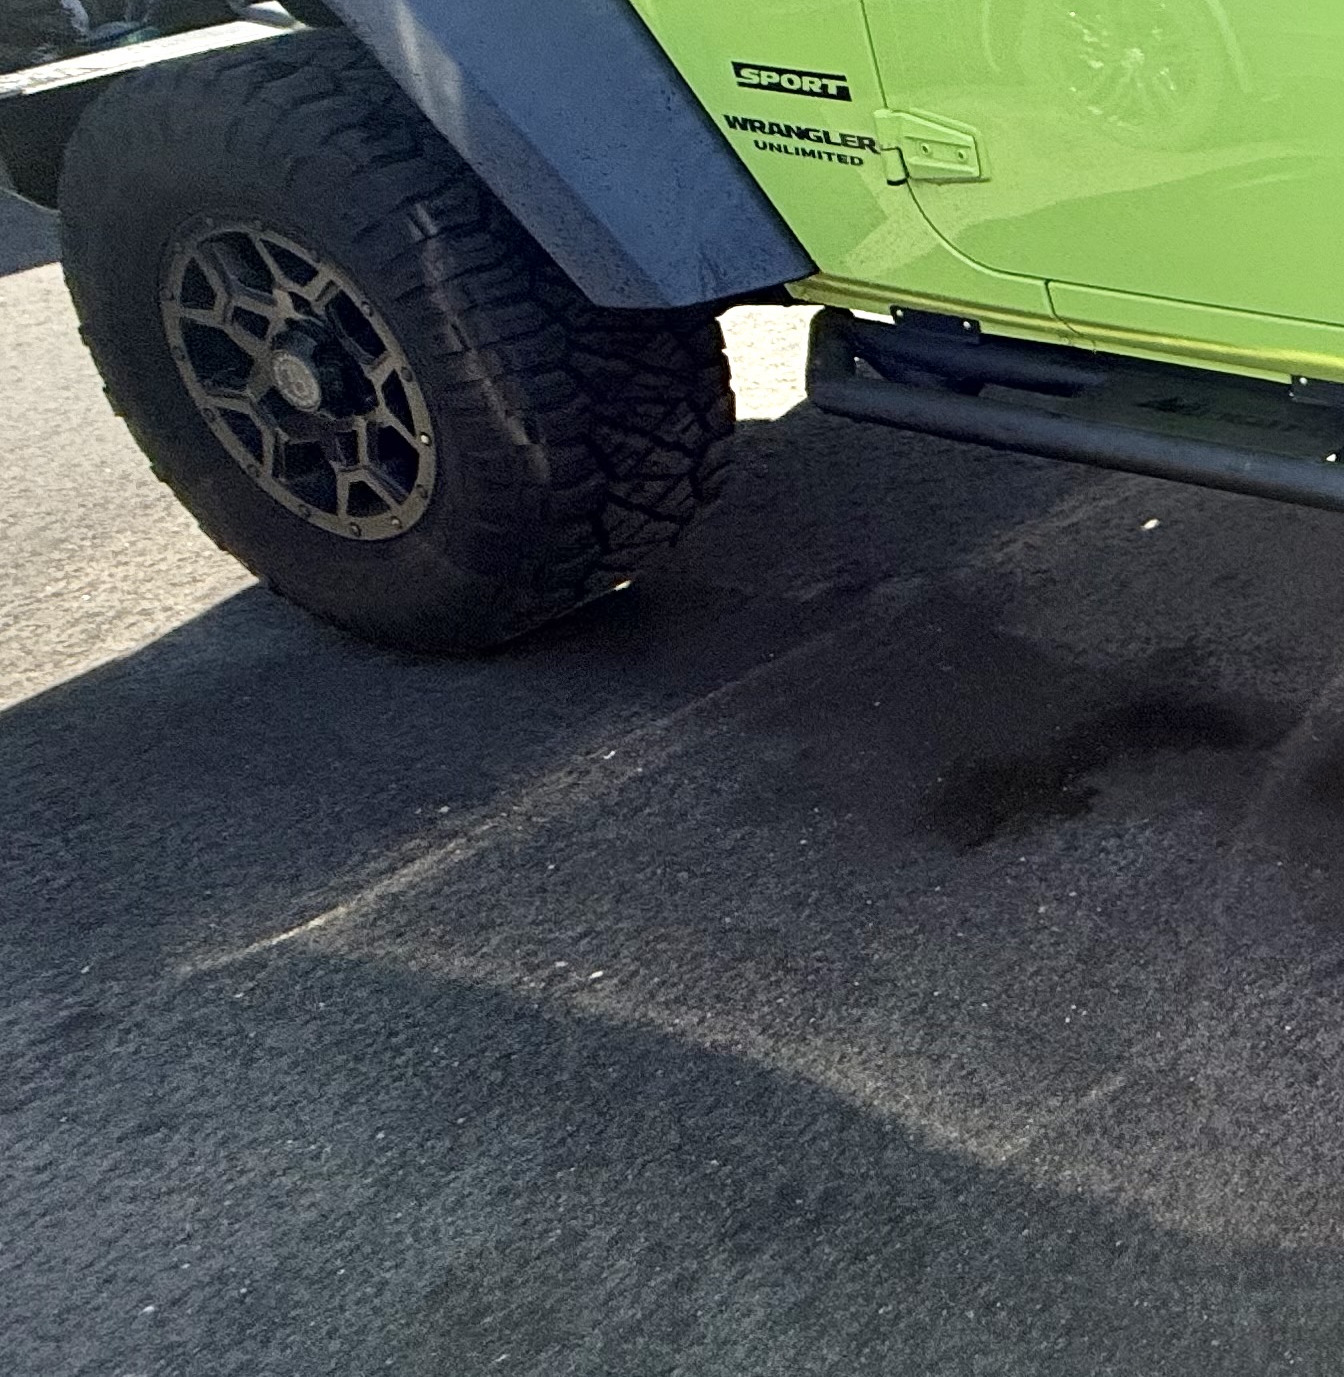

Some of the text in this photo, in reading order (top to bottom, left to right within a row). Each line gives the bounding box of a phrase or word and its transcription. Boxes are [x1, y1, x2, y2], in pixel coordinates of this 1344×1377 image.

[736, 67, 849, 97] SPORT
[723, 114, 881, 155] WRANGLER
[753, 139, 865, 167] UNLIMITED
